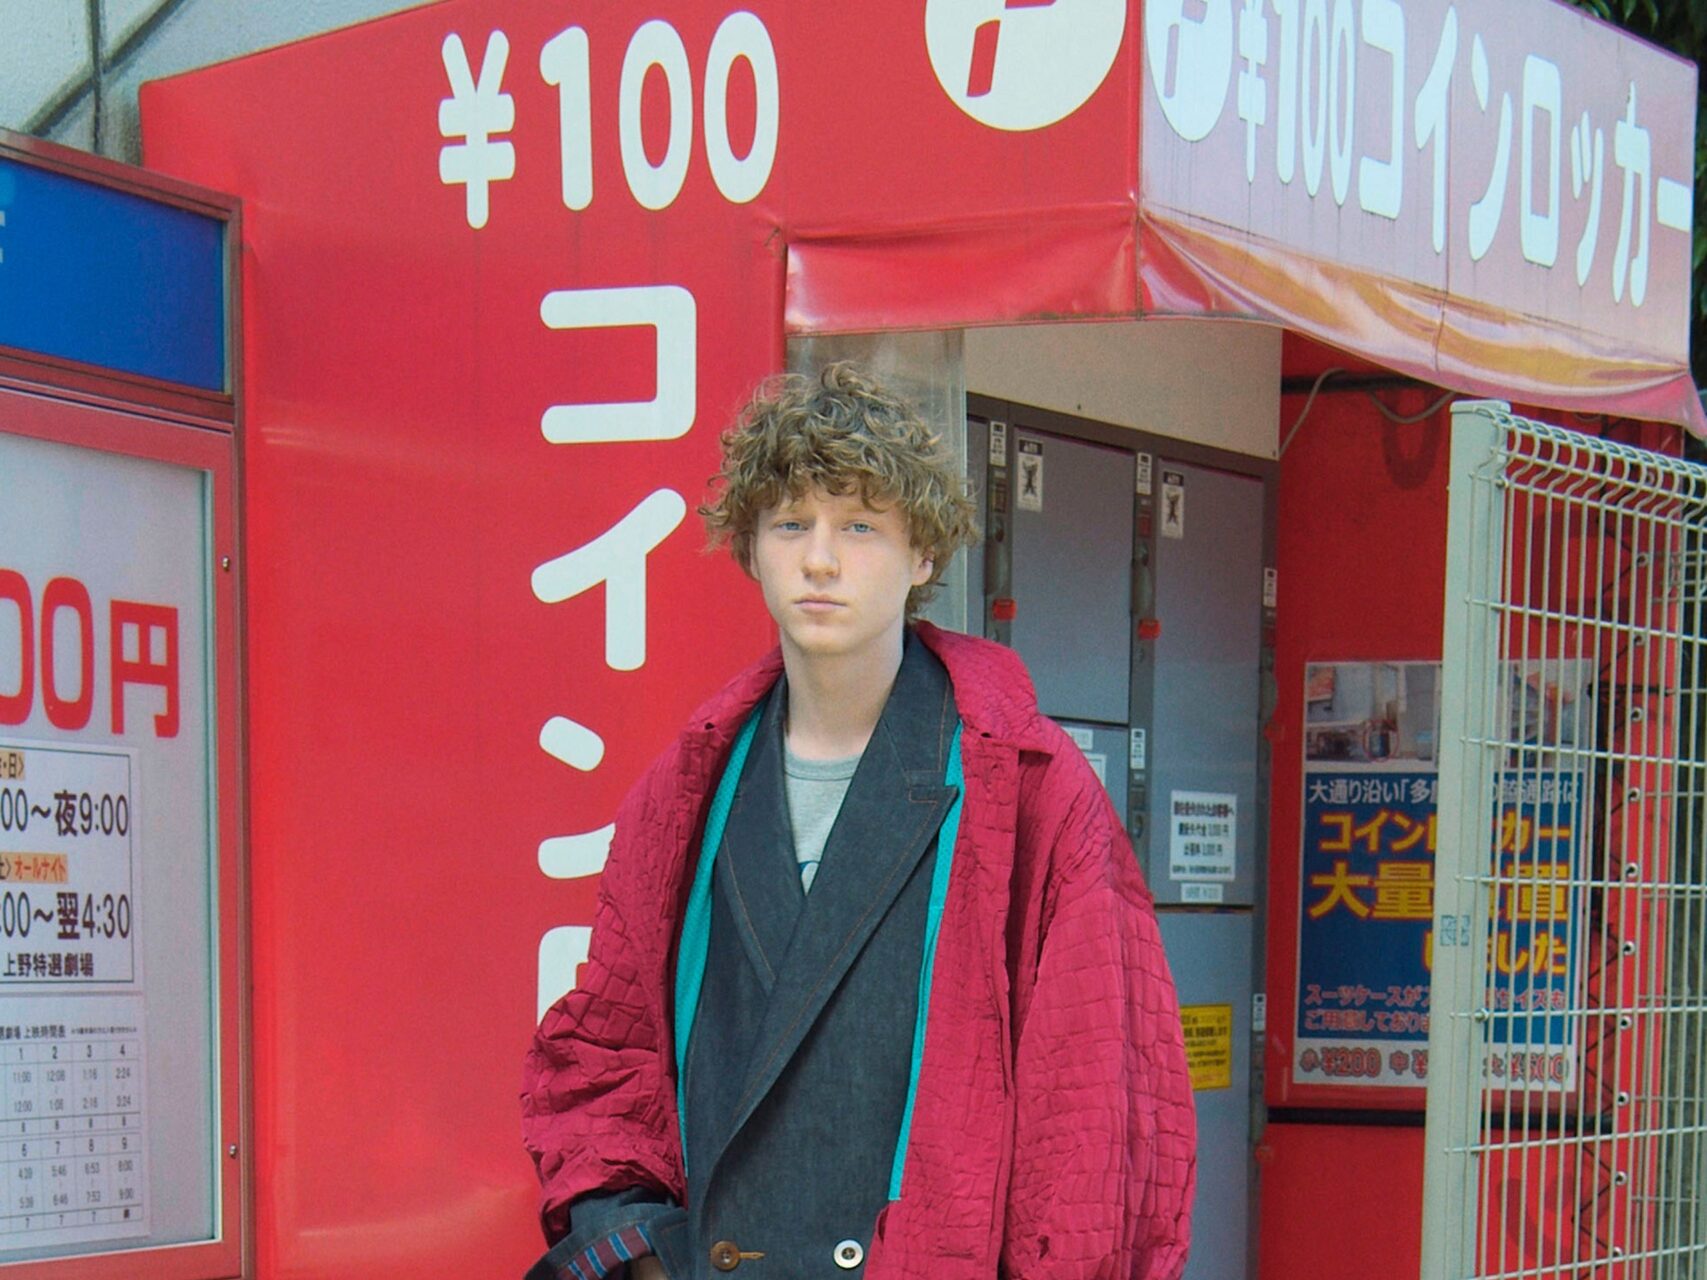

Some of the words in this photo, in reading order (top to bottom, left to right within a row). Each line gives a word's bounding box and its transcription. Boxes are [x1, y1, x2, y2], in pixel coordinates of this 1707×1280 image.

[438, 10, 780, 230] ¥100
[1237, 0, 1692, 307] ¥100コインロッカー
[1318, 808, 1572, 853] コインカー
[1307, 860, 1570, 920] 大量置
[3, 952, 94, 977] 上野特選劇場
